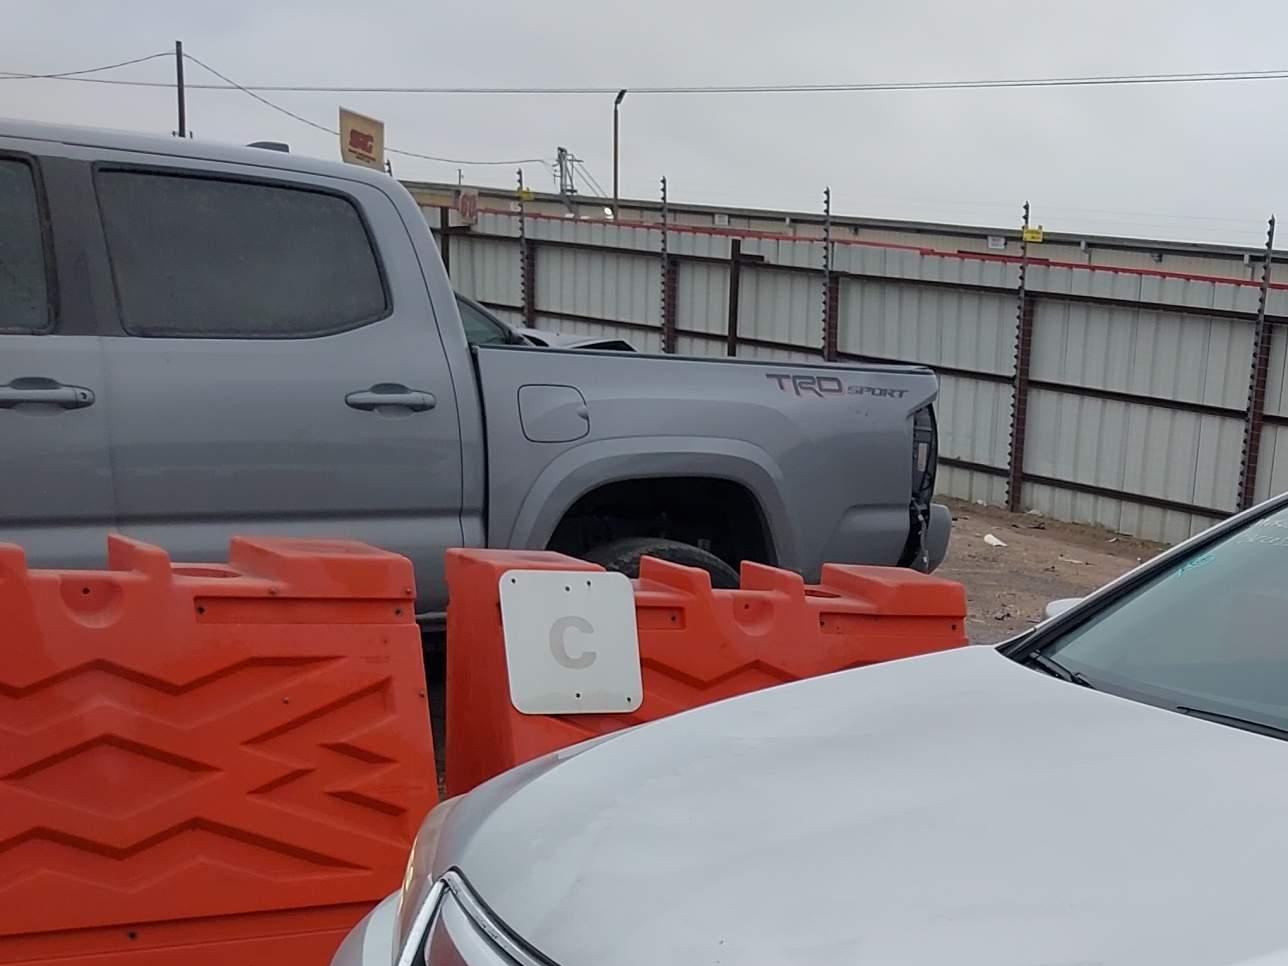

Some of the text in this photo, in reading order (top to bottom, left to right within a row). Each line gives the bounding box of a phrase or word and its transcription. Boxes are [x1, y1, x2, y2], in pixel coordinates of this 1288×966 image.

[765, 373, 910, 399] TRD SPORT
[548, 615, 598, 670] C
